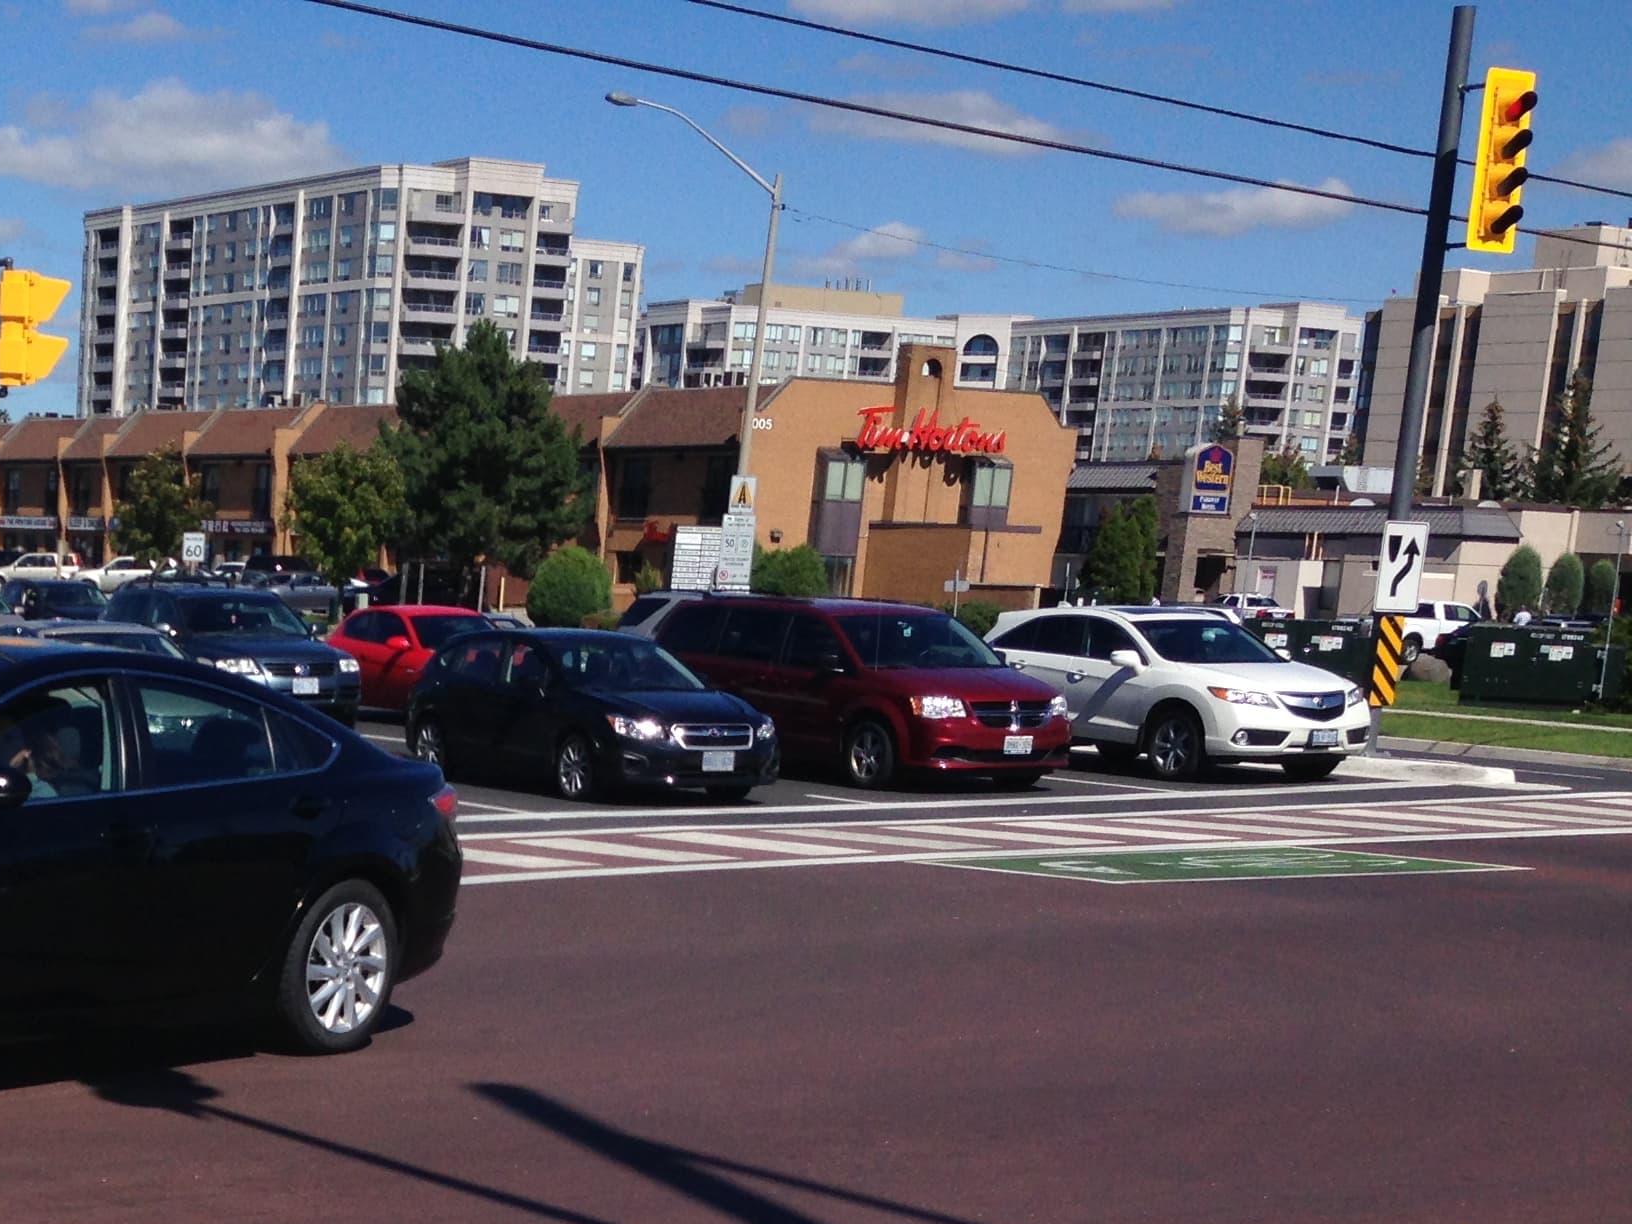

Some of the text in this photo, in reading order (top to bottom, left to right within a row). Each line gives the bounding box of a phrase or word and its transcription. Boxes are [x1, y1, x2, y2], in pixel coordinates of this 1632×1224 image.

[857, 405, 1006, 453] Tim Hortons
[1203, 460, 1223, 473] Best
[1196, 471, 1230, 484] Western
[185, 545, 202, 558] 60
